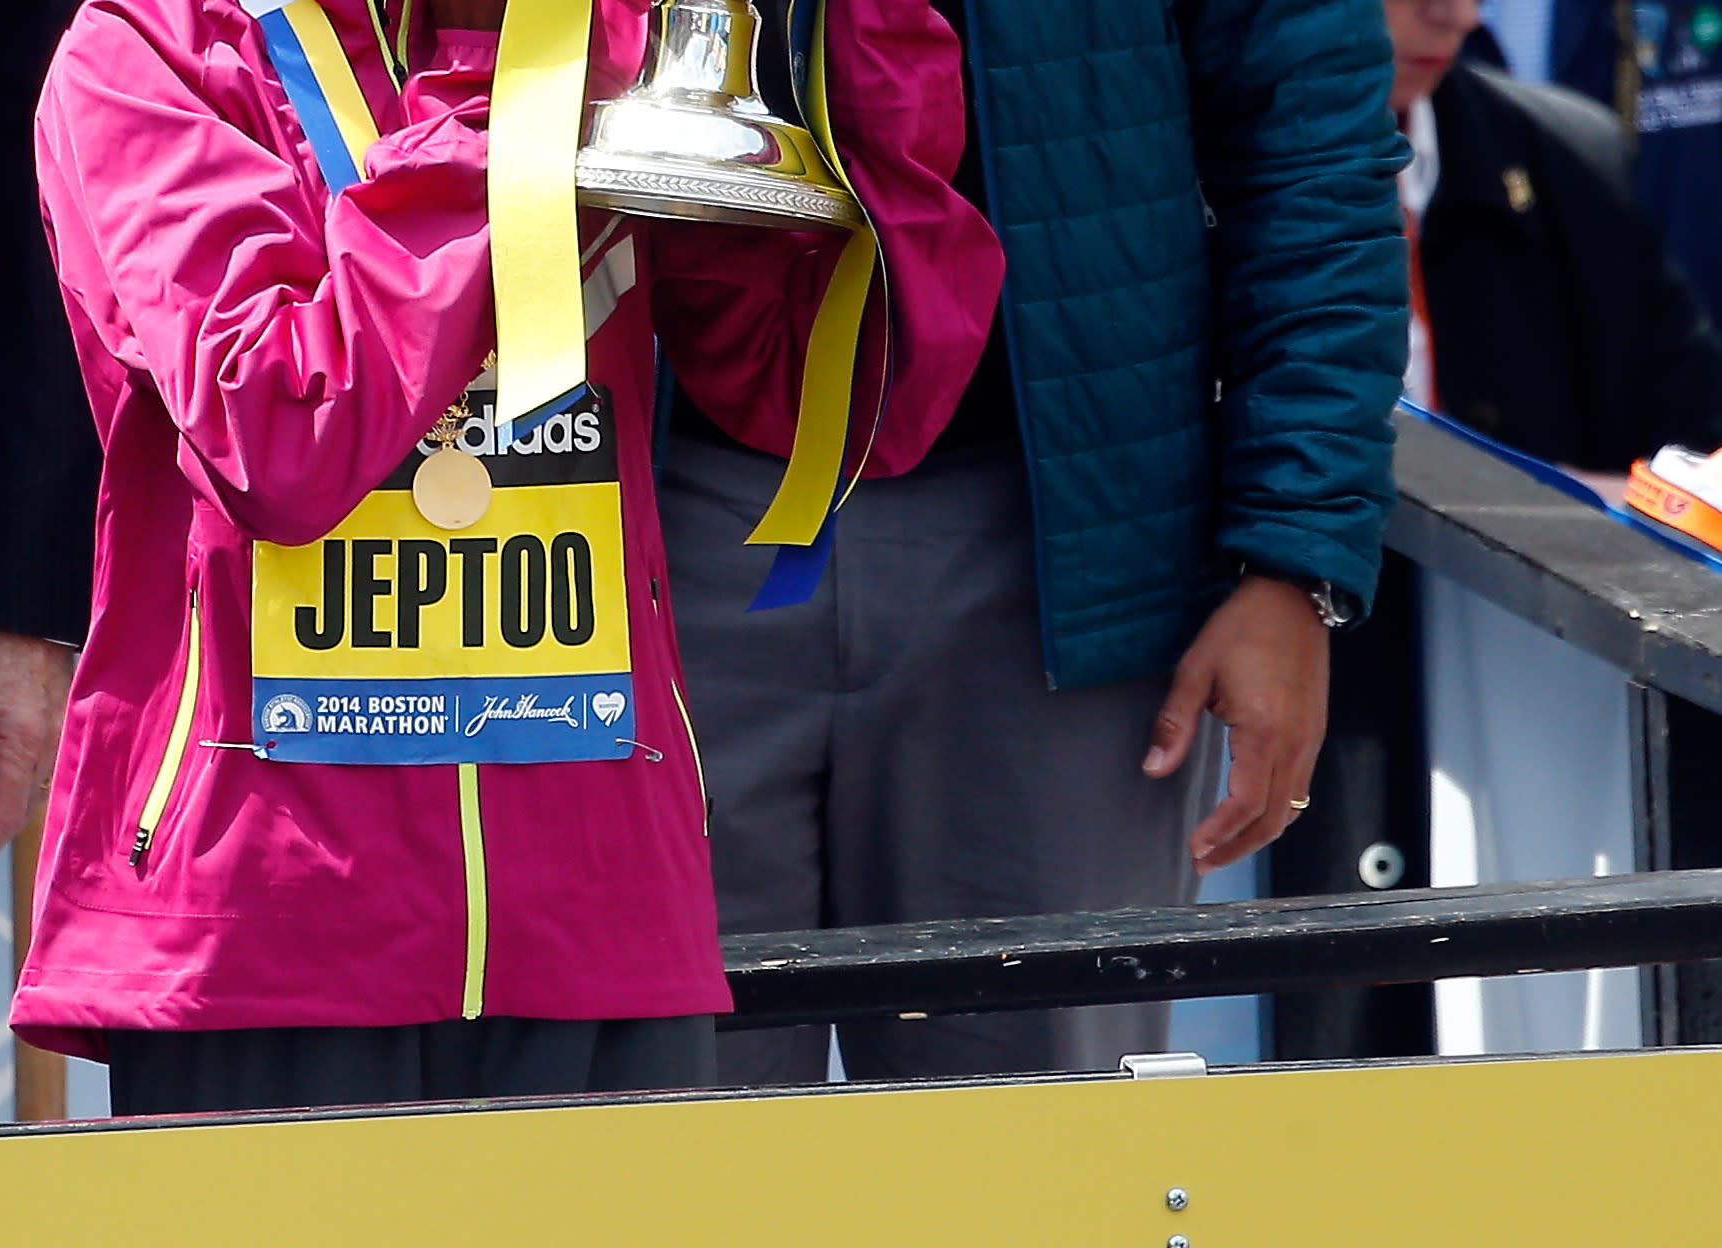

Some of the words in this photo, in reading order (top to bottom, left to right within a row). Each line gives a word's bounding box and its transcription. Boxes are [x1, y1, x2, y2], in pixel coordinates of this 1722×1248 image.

[294, 530, 595, 651] JEPTOO
[317, 696, 362, 714] 2014
[369, 694, 445, 714] BOSTON
[317, 714, 446, 735] MARATHON
